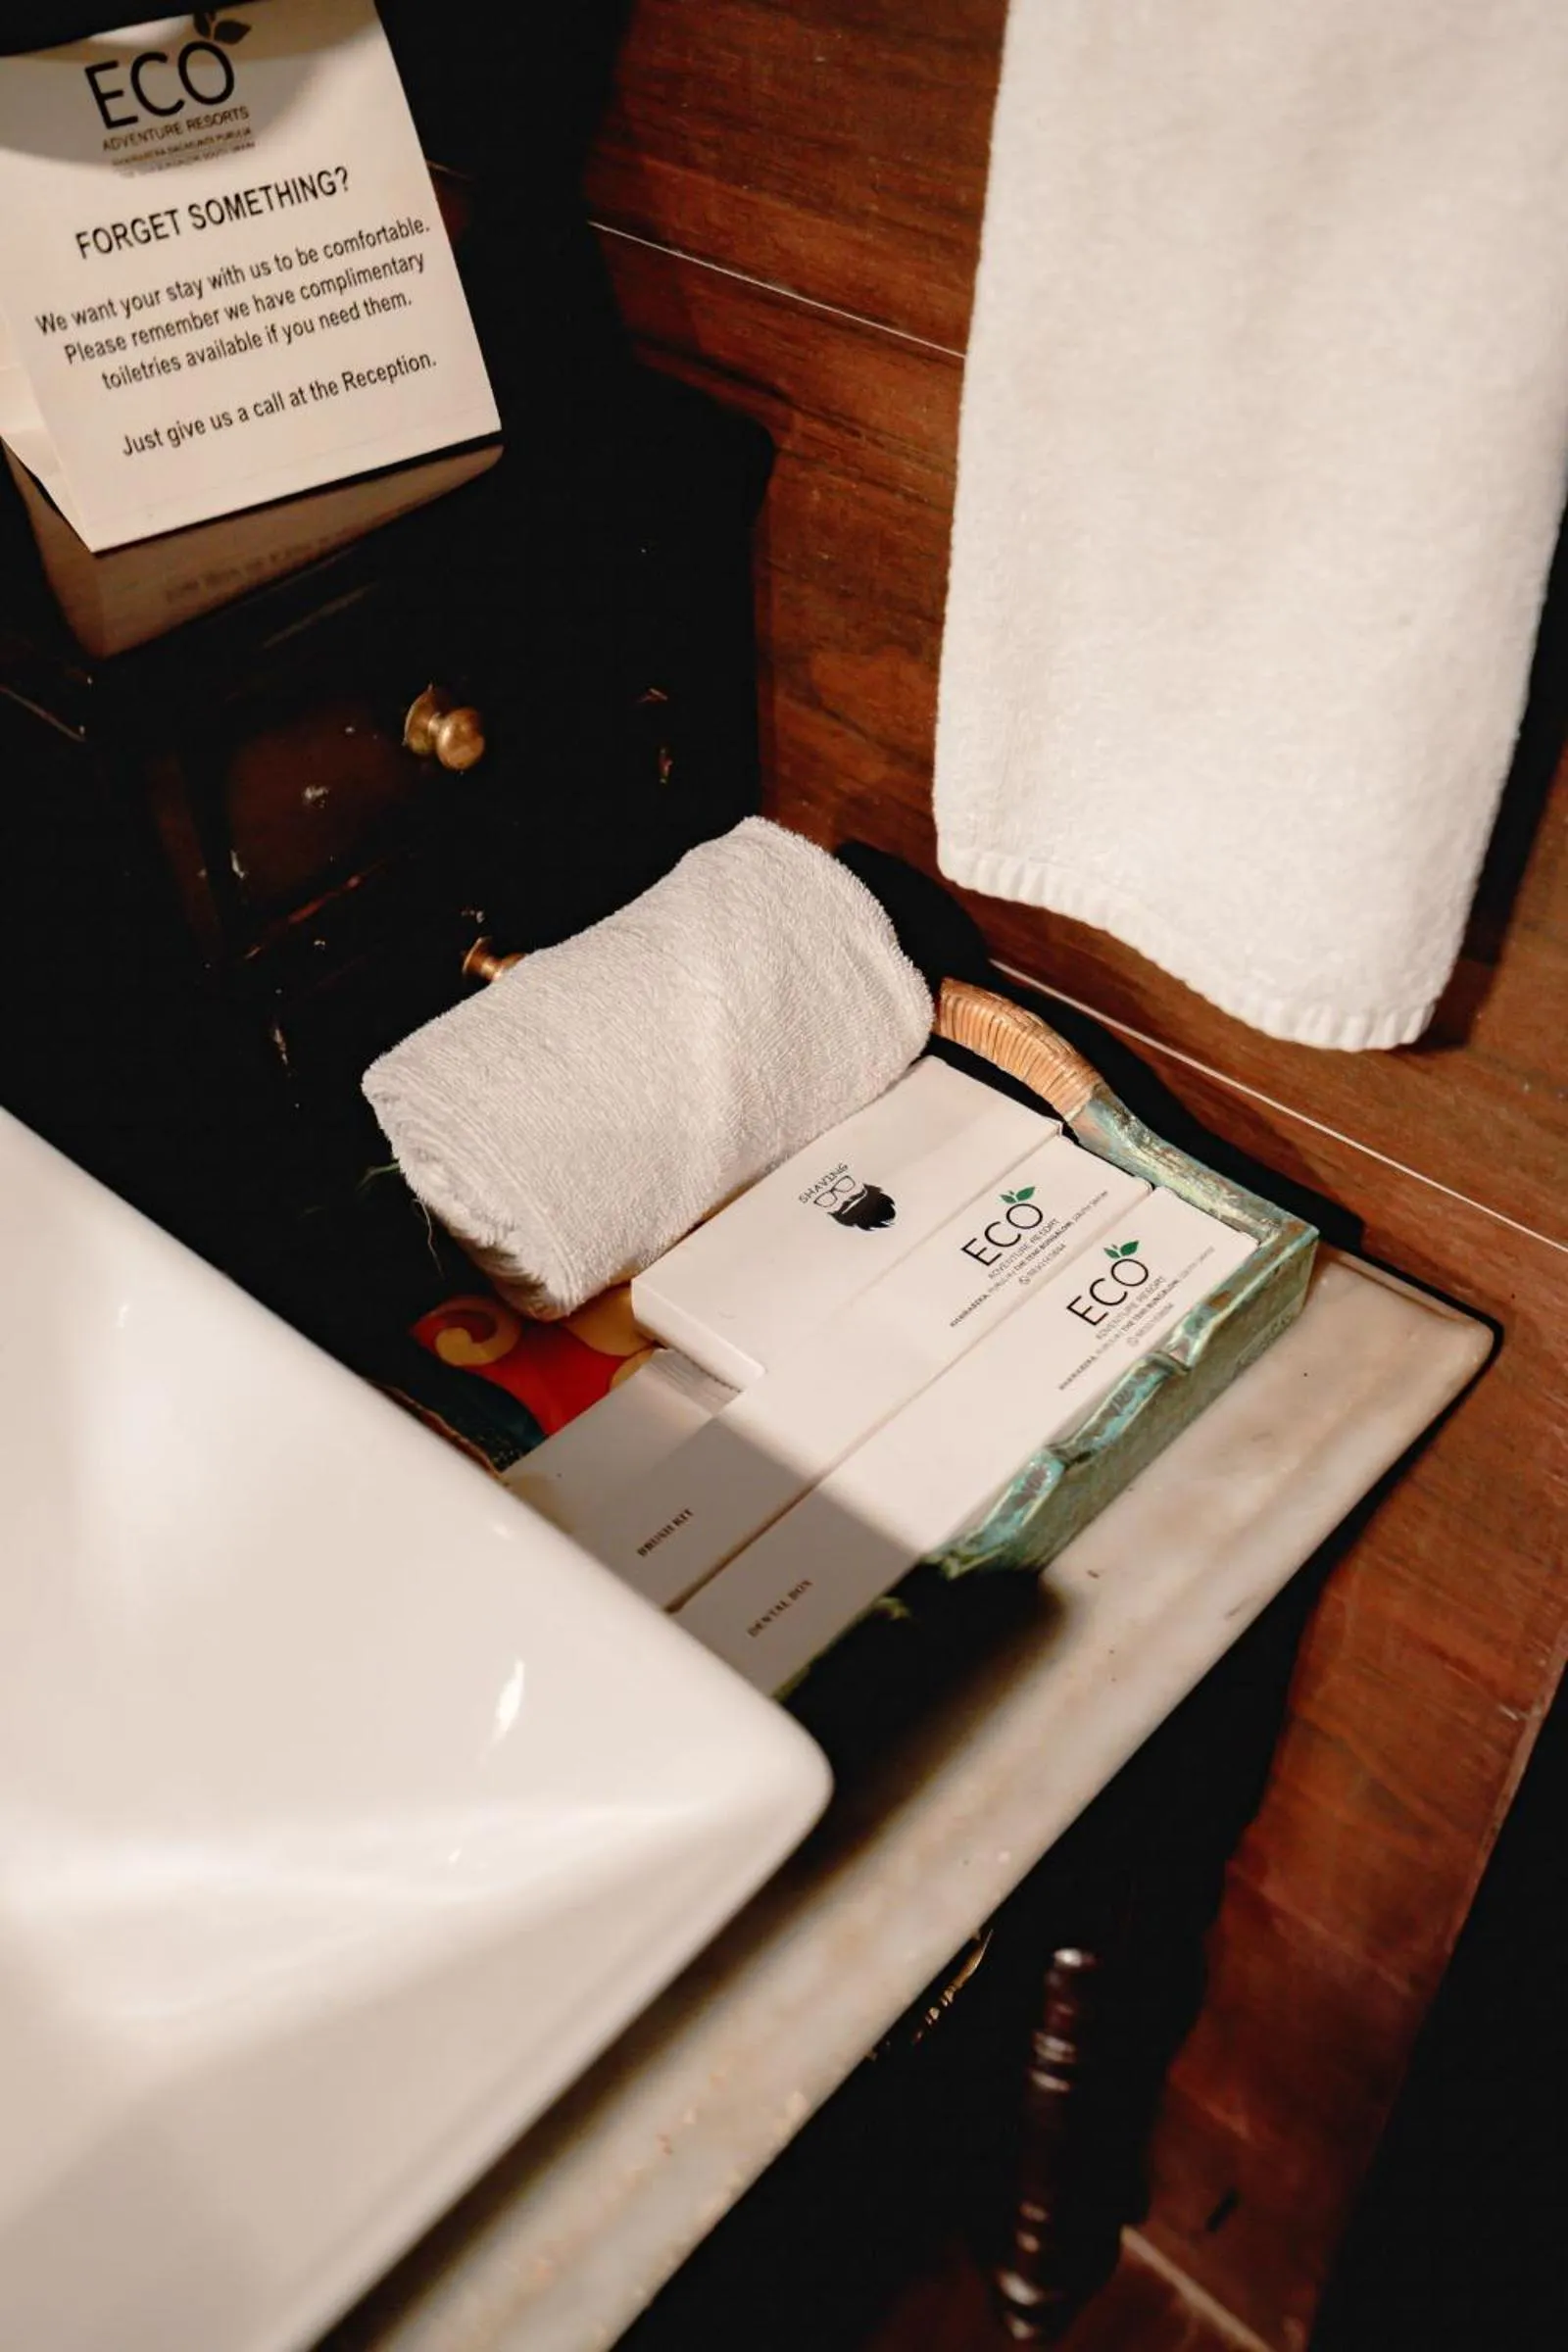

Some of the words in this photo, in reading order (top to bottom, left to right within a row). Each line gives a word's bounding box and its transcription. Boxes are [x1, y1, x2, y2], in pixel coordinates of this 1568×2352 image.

[84, 40, 235, 130] ECO
[103, 122, 184, 152] ADVENTURE
[186, 106, 251, 132] RESORTS
[75, 209, 181, 260] FORGET
[187, 166, 350, 230] SOMETHING?
[35, 313, 69, 335] We
[72, 299, 118, 327] want
[120, 290, 162, 319] your
[166, 279, 204, 302] stay
[207, 265, 245, 290] with
[249, 261, 271, 279] us
[274, 254, 293, 272] to
[295, 246, 319, 267] be
[322, 217, 430, 260] comfortable.
[64, 335, 127, 365] Please
[131, 308, 220, 347] remember
[223, 302, 251, 321] we
[252, 289, 296, 314] have
[300, 252, 424, 301] complimentary
[102, 355, 181, 390] toiletries
[185, 330, 263, 368] available
[265, 323, 279, 344] if
[281, 318, 315, 345] you
[318, 302, 361, 330] need
[364, 292, 413, 318] them.
[122, 428, 164, 457] Just
[167, 418, 206, 448] give
[210, 410, 233, 432] us
[237, 405, 250, 422] a
[253, 392, 285, 418] call
[290, 386, 308, 408] at
[309, 379, 339, 403] the
[341, 353, 437, 393] Reception.
[799, 1162, 849, 1203] SHAVING
[960, 1203, 1043, 1266] ECO
[1066, 1258, 1149, 1326] ECO
[637, 1525, 675, 1557] BRUSH
[672, 1509, 694, 1527] KIT
[747, 1599, 790, 1638] DENTAL
[787, 1580, 812, 1601] BOX
